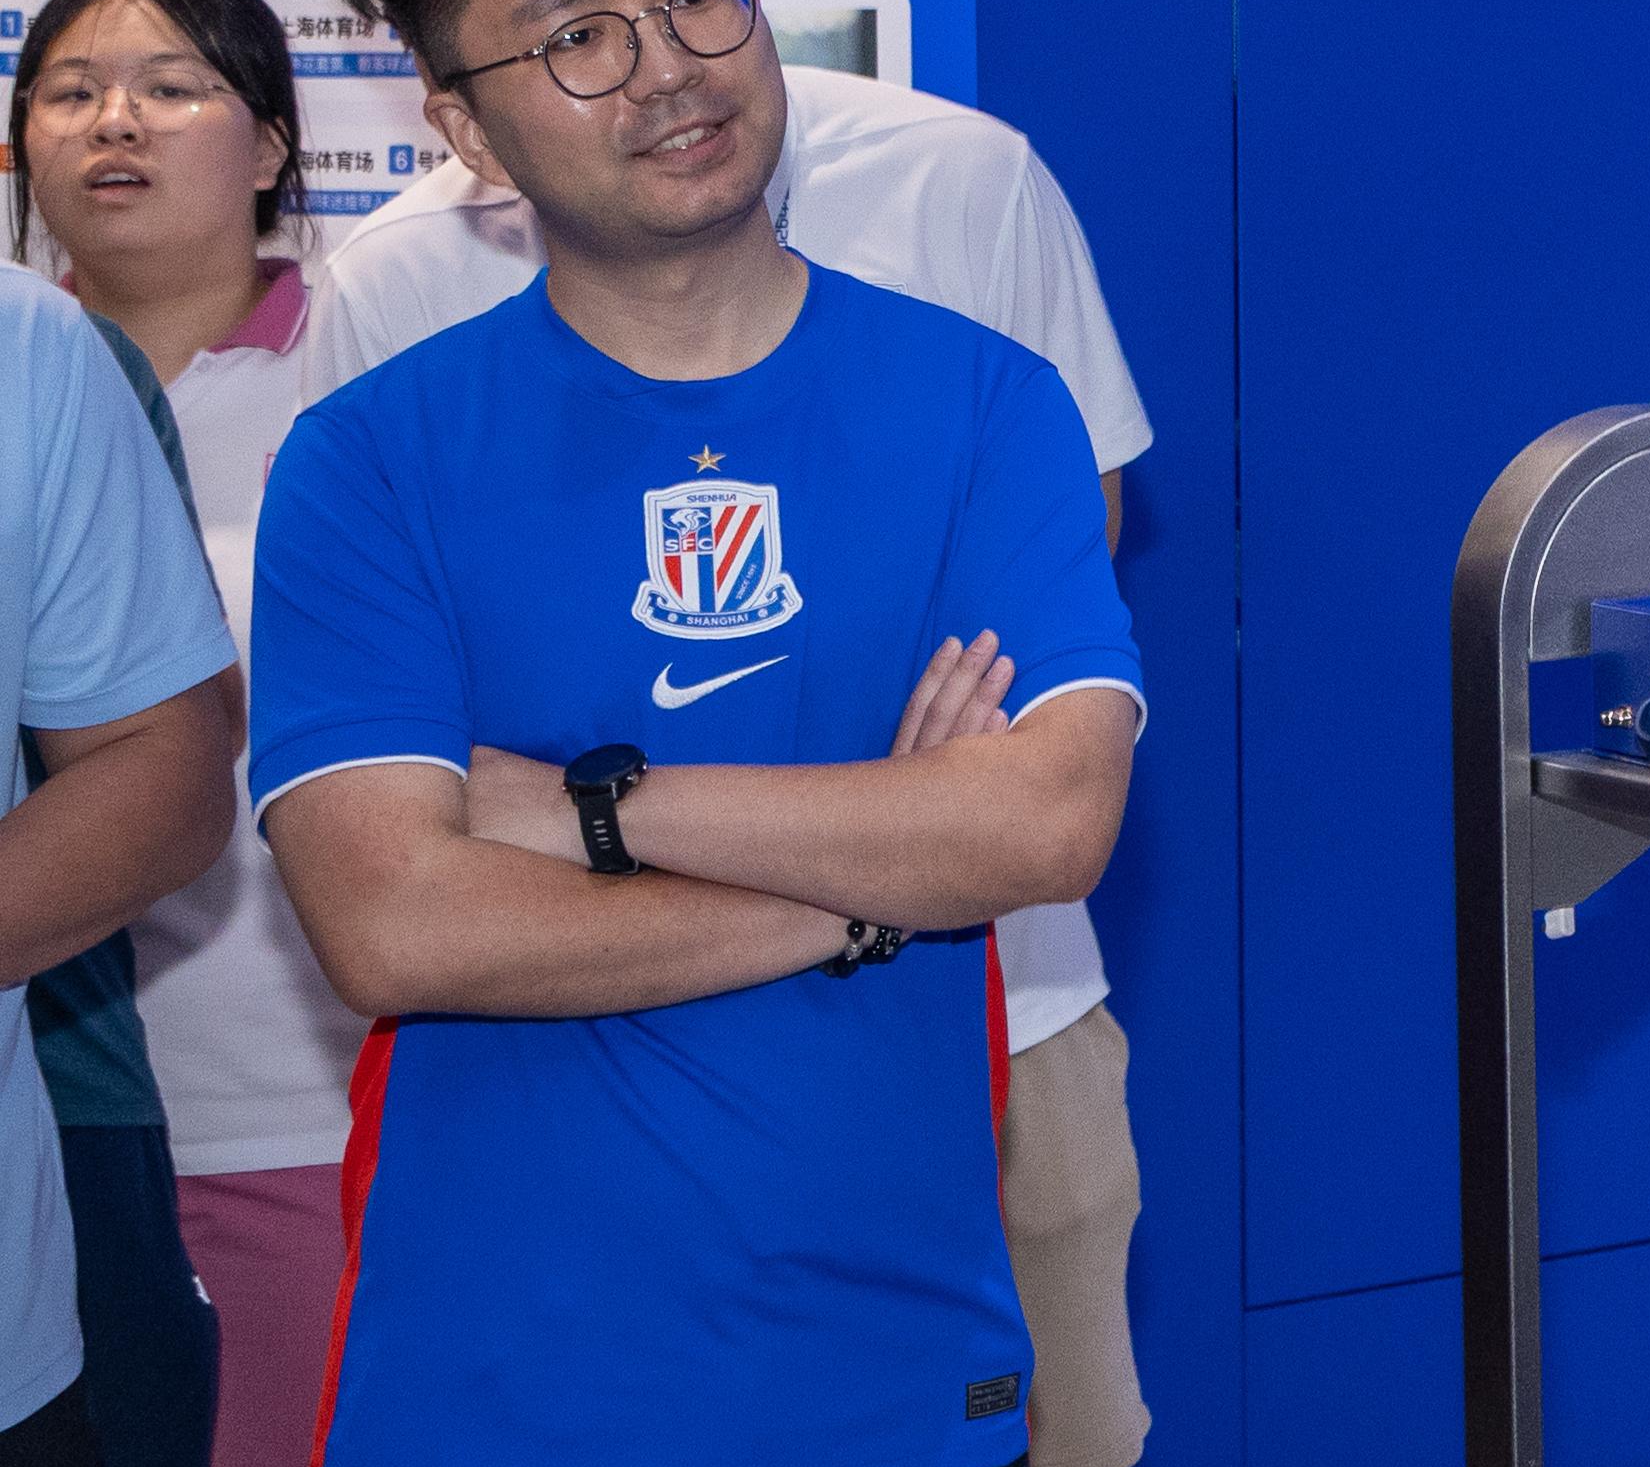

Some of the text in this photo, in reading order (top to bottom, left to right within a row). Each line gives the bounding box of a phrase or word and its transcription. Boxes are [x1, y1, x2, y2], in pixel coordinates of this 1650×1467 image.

[686, 492, 738, 504] SHENHUA
[664, 537, 715, 553] SFC
[685, 613, 750, 628] SHANGHAI
